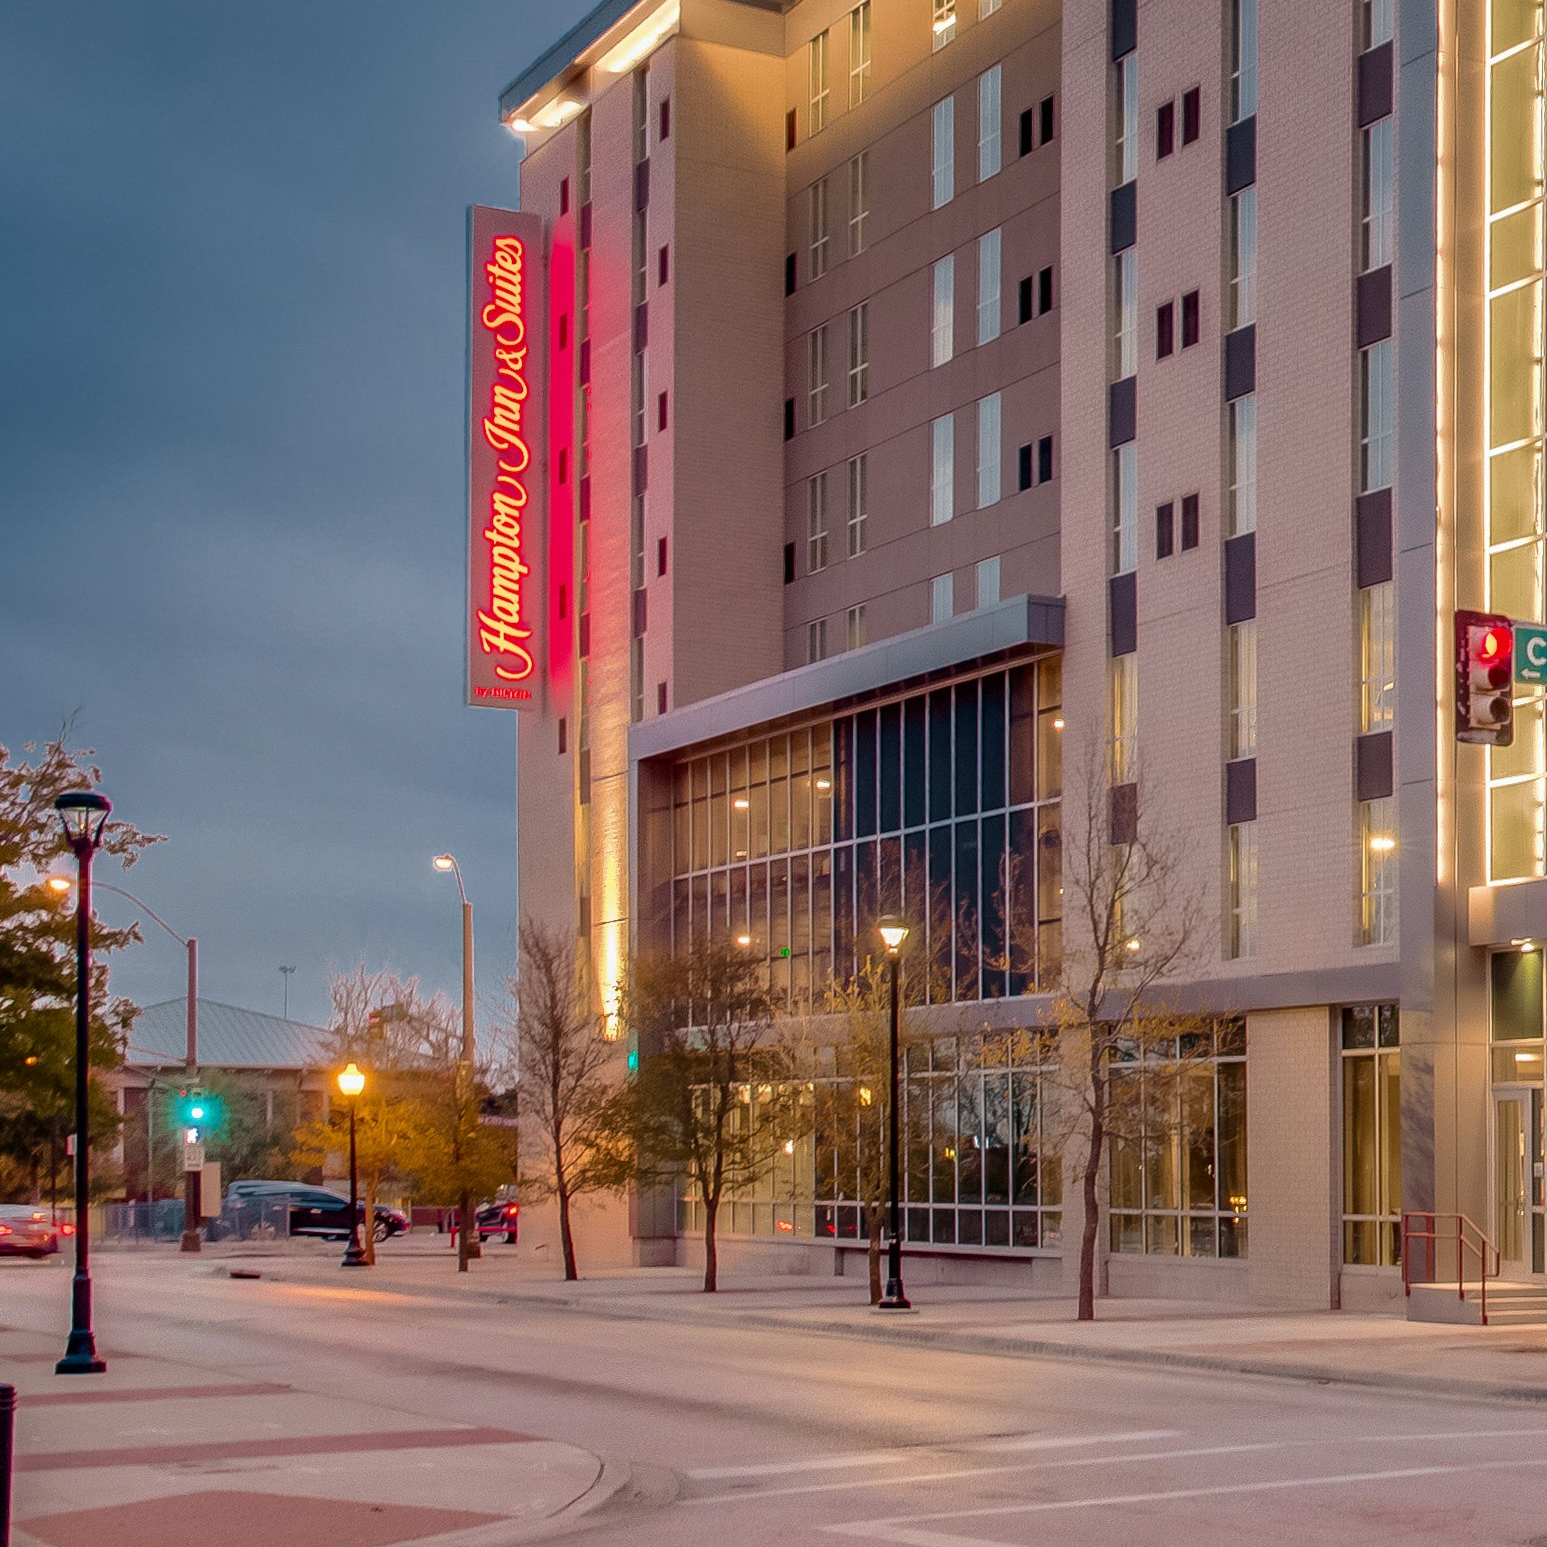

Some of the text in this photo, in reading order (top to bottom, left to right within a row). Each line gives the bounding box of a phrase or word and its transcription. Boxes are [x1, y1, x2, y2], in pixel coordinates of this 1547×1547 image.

[477, 237, 533, 679] Hampton Inn & Suites
